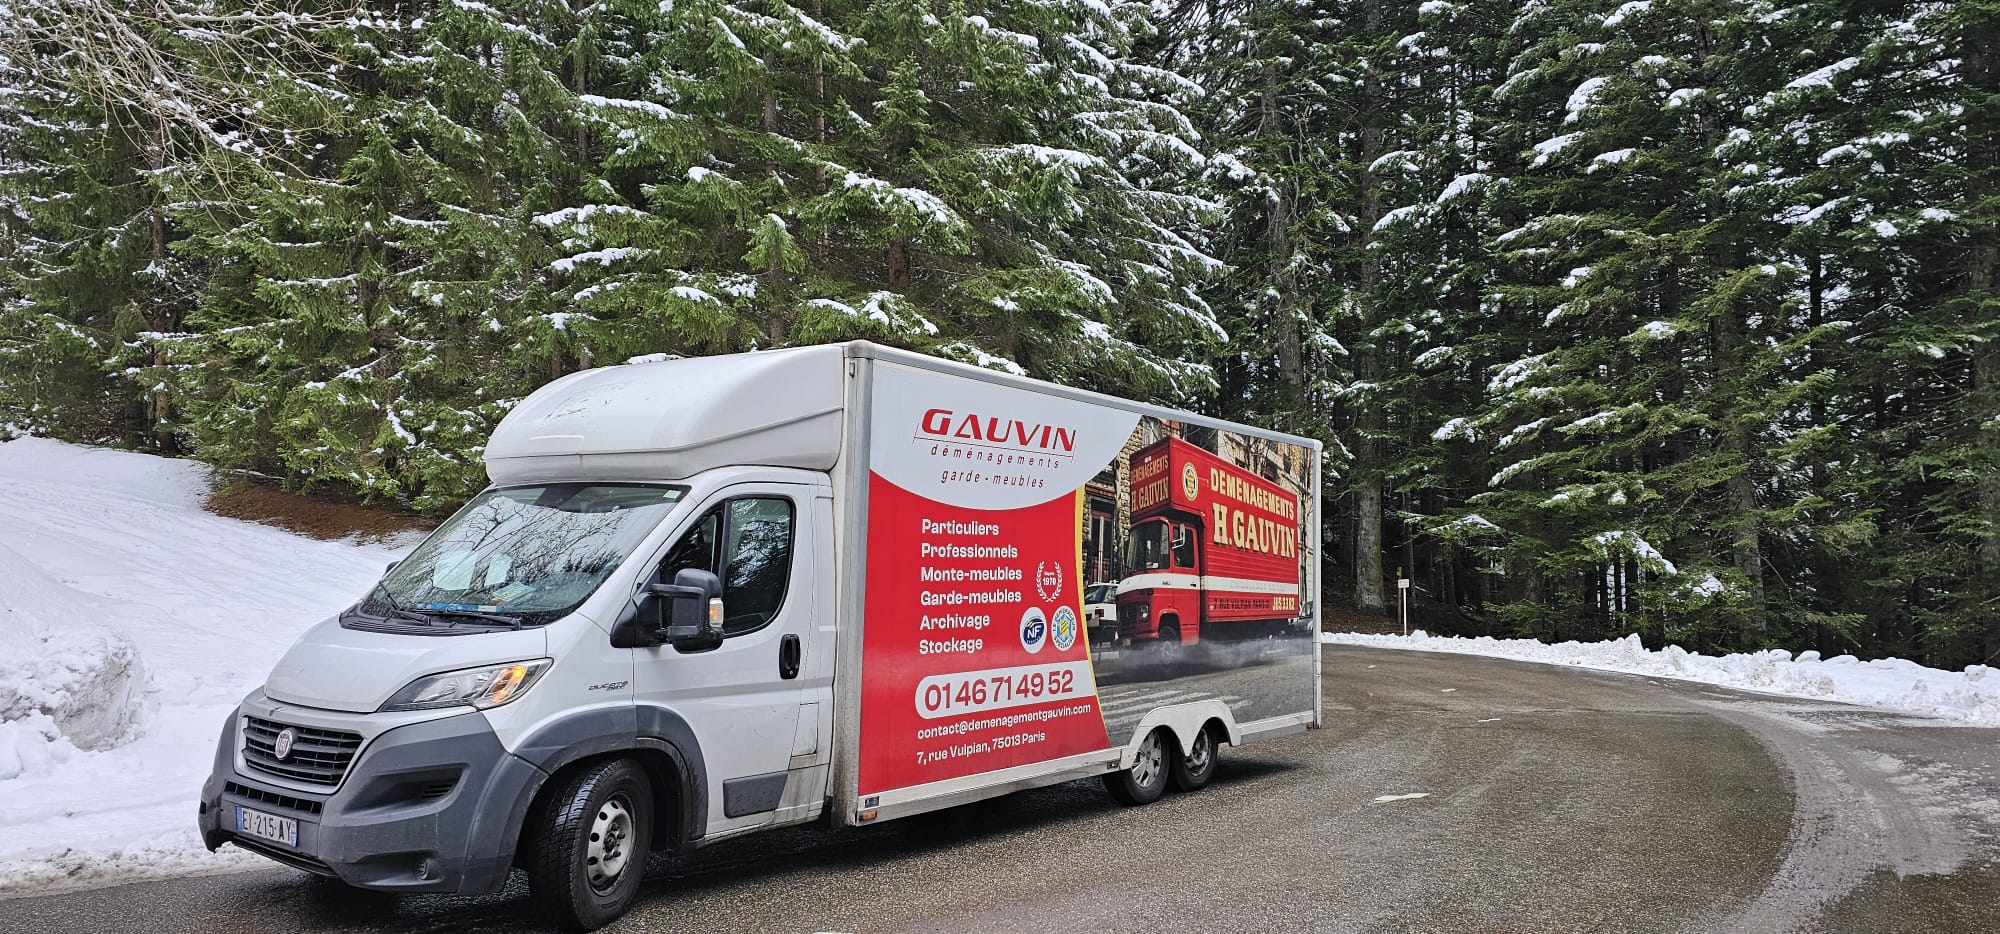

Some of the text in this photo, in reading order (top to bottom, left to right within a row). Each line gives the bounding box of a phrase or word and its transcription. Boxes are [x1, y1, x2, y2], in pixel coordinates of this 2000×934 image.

[921, 408, 1077, 452] GAUVIN
[930, 443, 1060, 469] déménagements
[1210, 467, 1294, 520] DEMENAGEMENTS
[922, 518, 999, 536] Particuliers
[921, 542, 1018, 559] Professionnels
[920, 566, 1022, 582] Monte-meubles
[1042, 577, 1057, 586] 1970
[920, 588, 1022, 606] Garde-meubles
[920, 613, 990, 630] Archivage
[1027, 625, 1042, 639] NF
[919, 636, 983, 655] Stockage
[955, 678, 987, 707] 46
[1016, 672, 1044, 698] 49
[1048, 669, 1073, 694] 52
[917, 703, 1091, 740] contact@demenagementgauvin.com
[928, 748, 948, 762] rue
[949, 741, 991, 759] Vulpian,
[992, 735, 1020, 750] 75013
[1022, 730, 1046, 745] Paris
